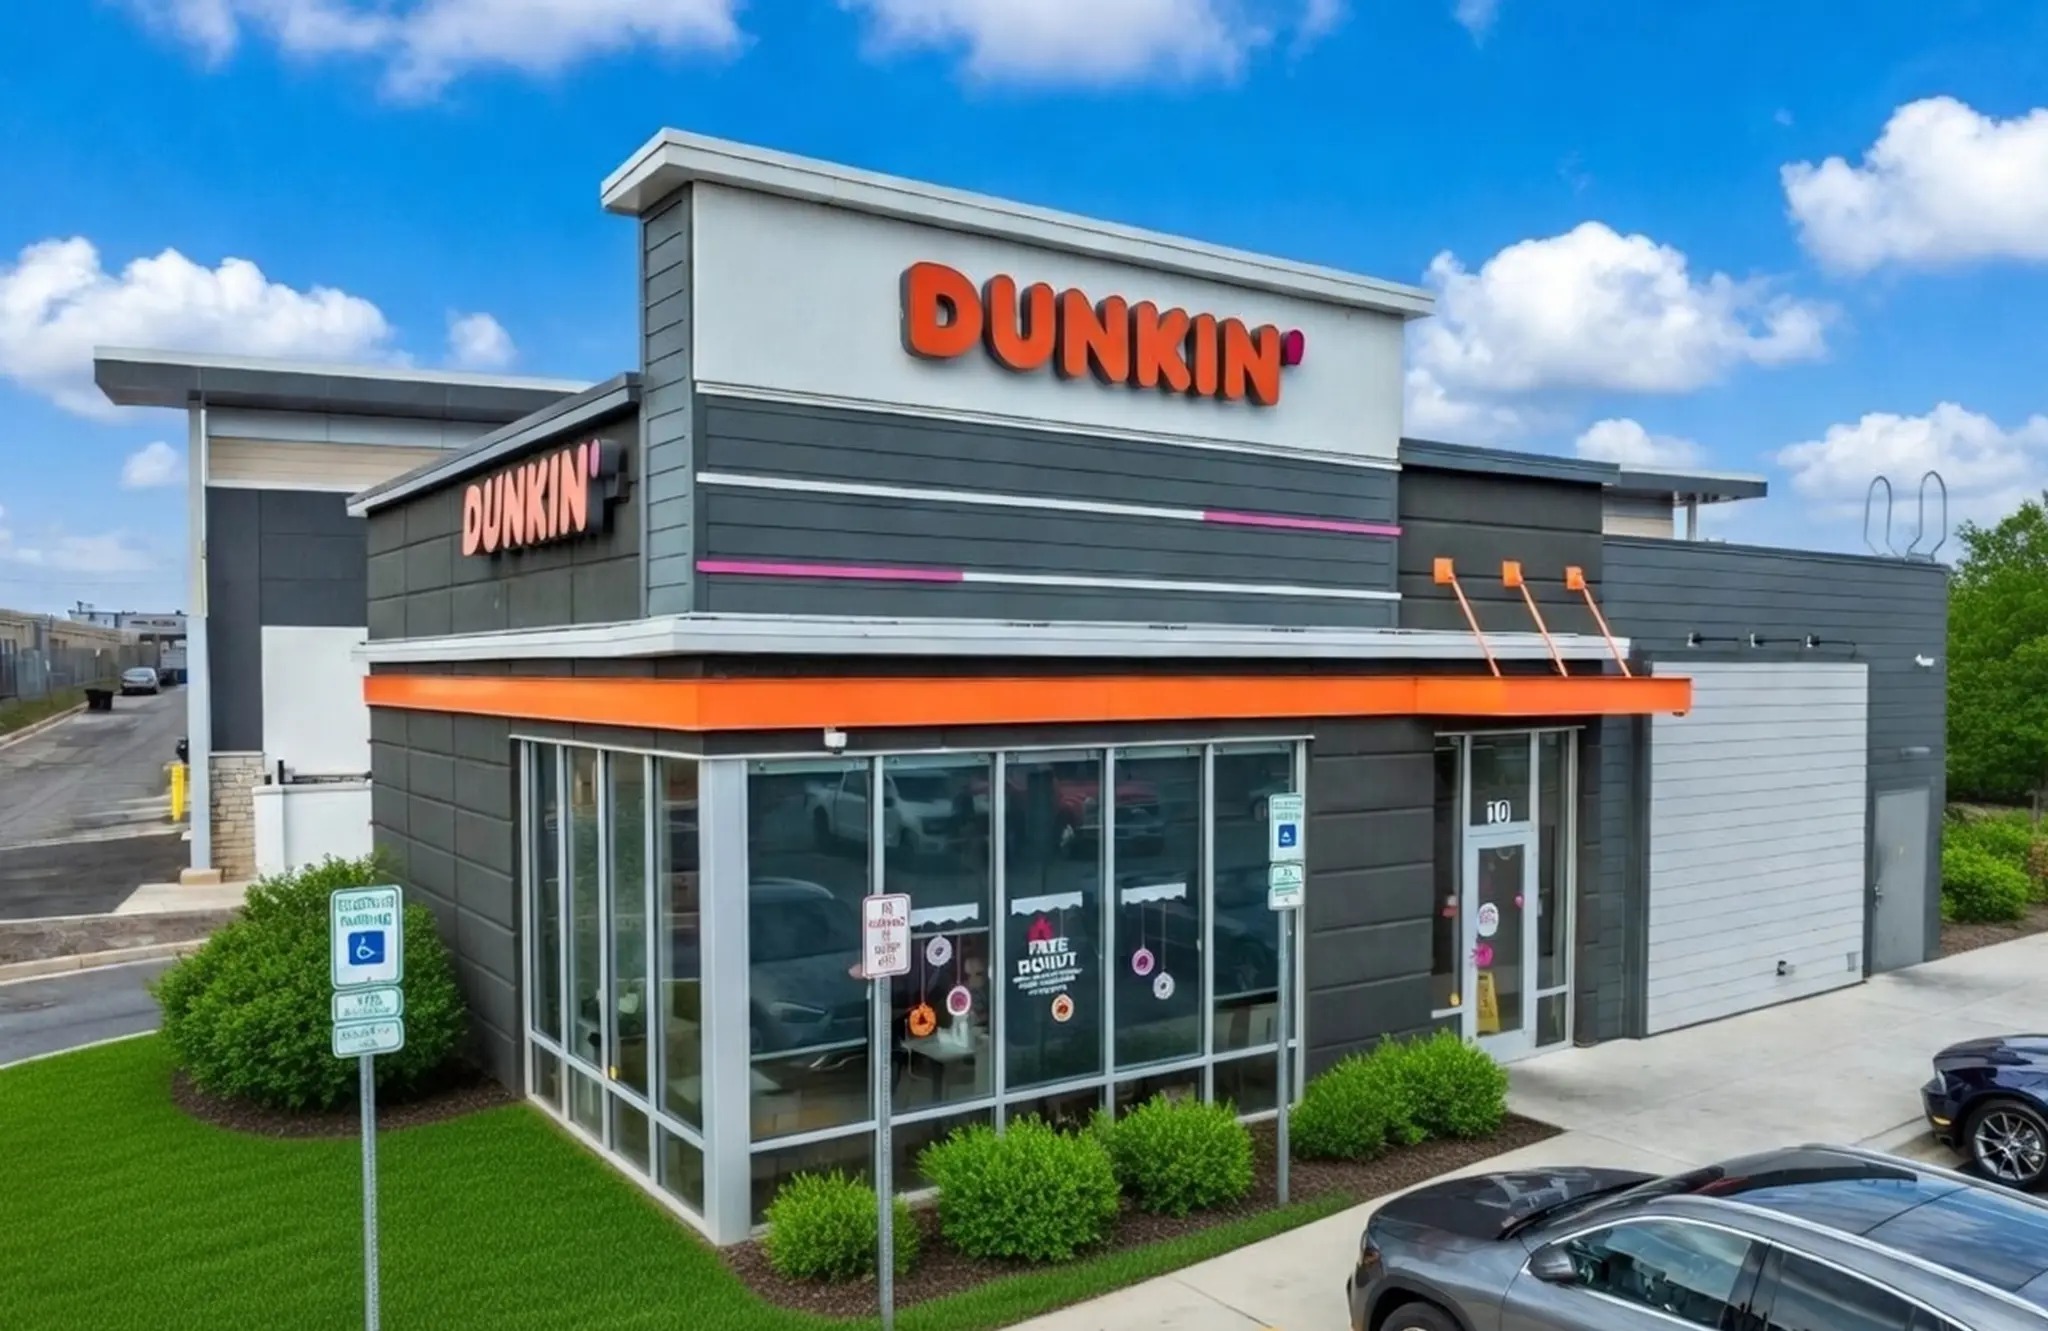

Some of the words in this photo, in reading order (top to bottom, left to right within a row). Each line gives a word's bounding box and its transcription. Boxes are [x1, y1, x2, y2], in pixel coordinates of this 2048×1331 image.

[900, 261, 1305, 406] DUNKIN'
[462, 438, 601, 557] DUNKIN'
[1486, 799, 1511, 824] 10
